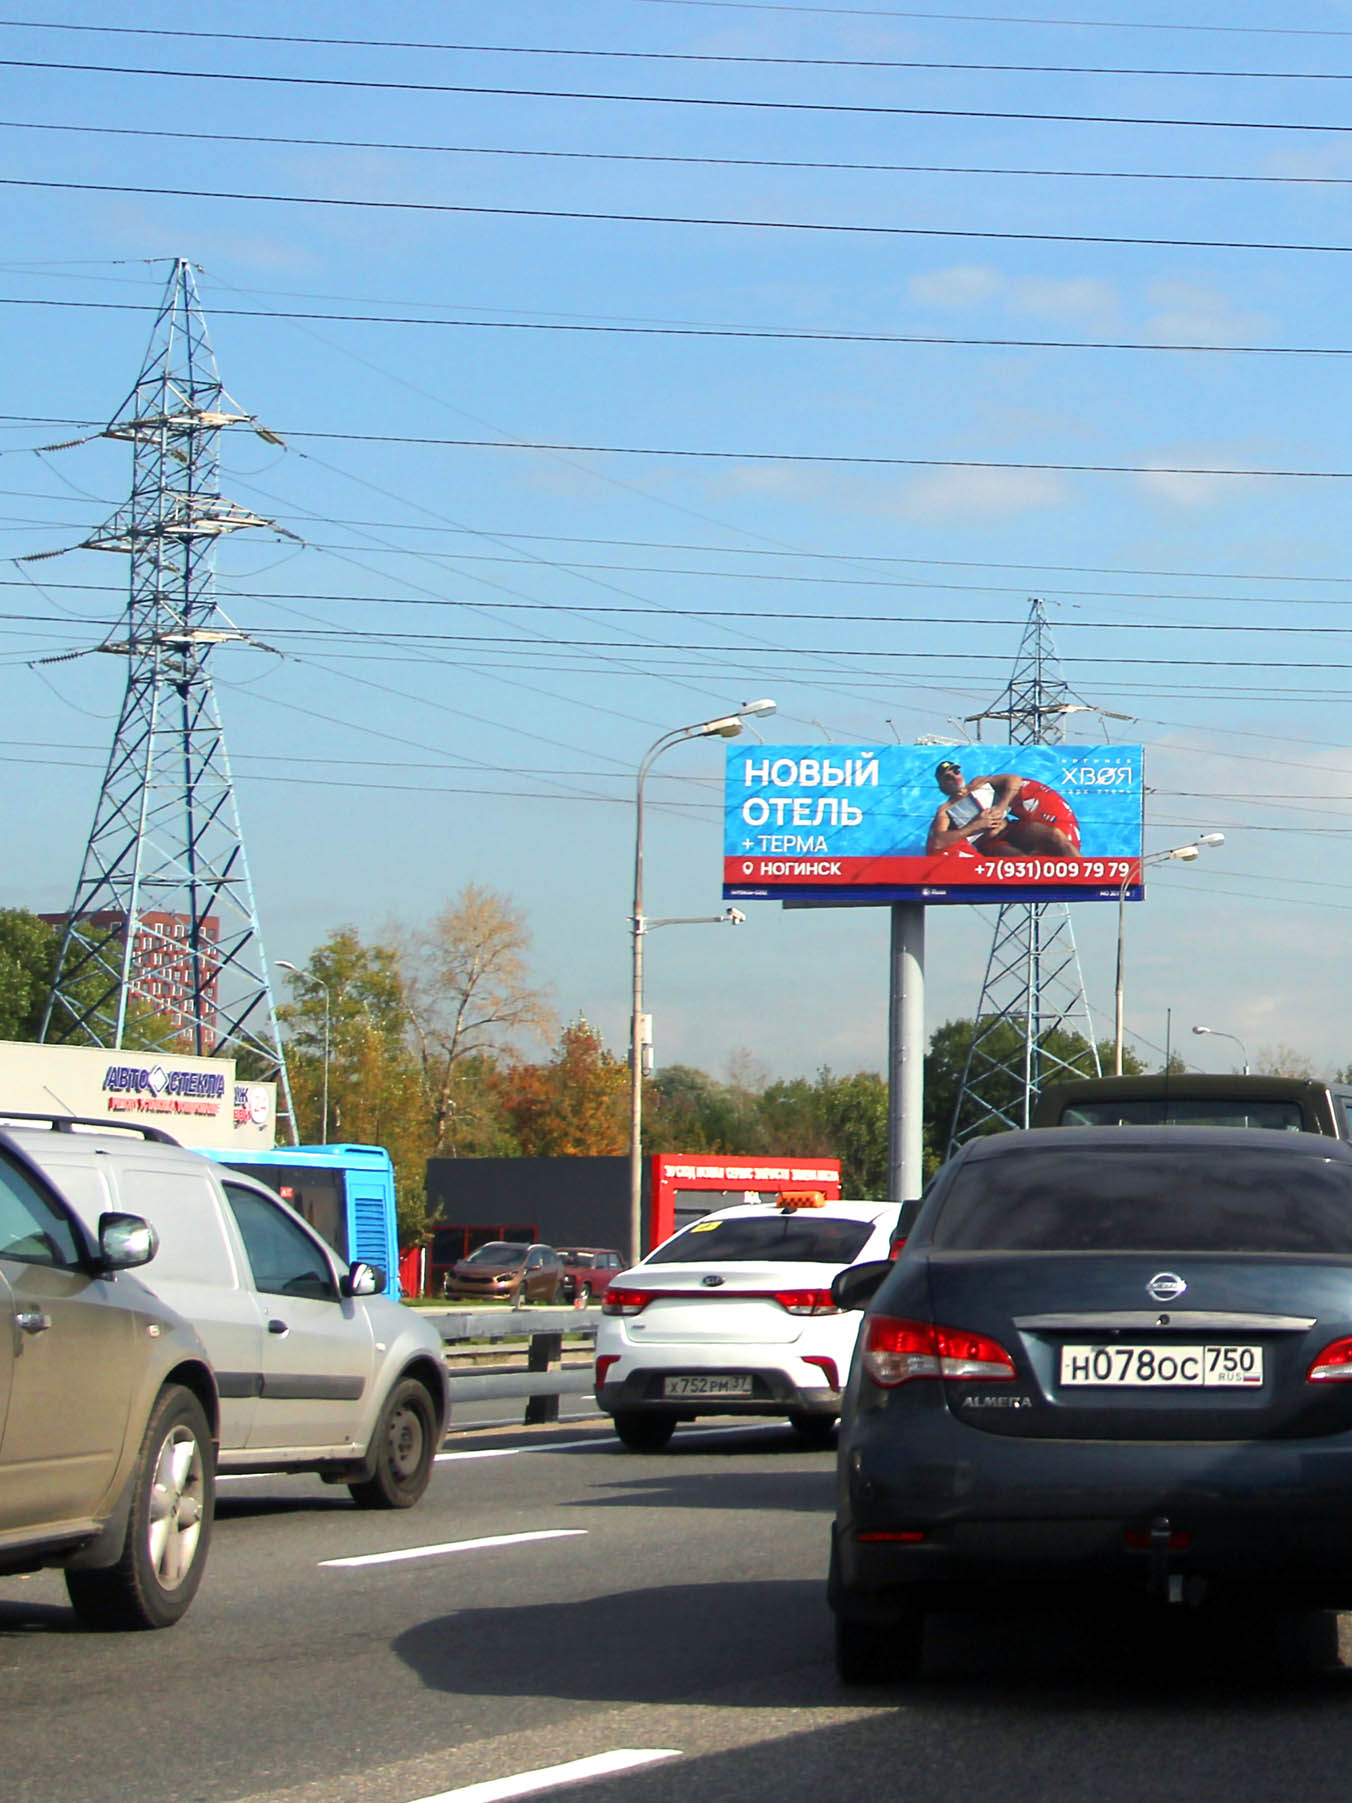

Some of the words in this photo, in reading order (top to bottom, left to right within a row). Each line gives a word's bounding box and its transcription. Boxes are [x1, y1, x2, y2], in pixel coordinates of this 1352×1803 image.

[744, 752, 879, 787] НОВЫЙ
[742, 797, 864, 826] ОТЕЛЬ
[757, 835, 829, 853] ТЕРМА
[760, 861, 842, 876] НОГИНСК
[1071, 1349, 1199, 1381] Н078ОС
[1207, 1348, 1255, 1372] 750
[1218, 1372, 1242, 1382] RUS
